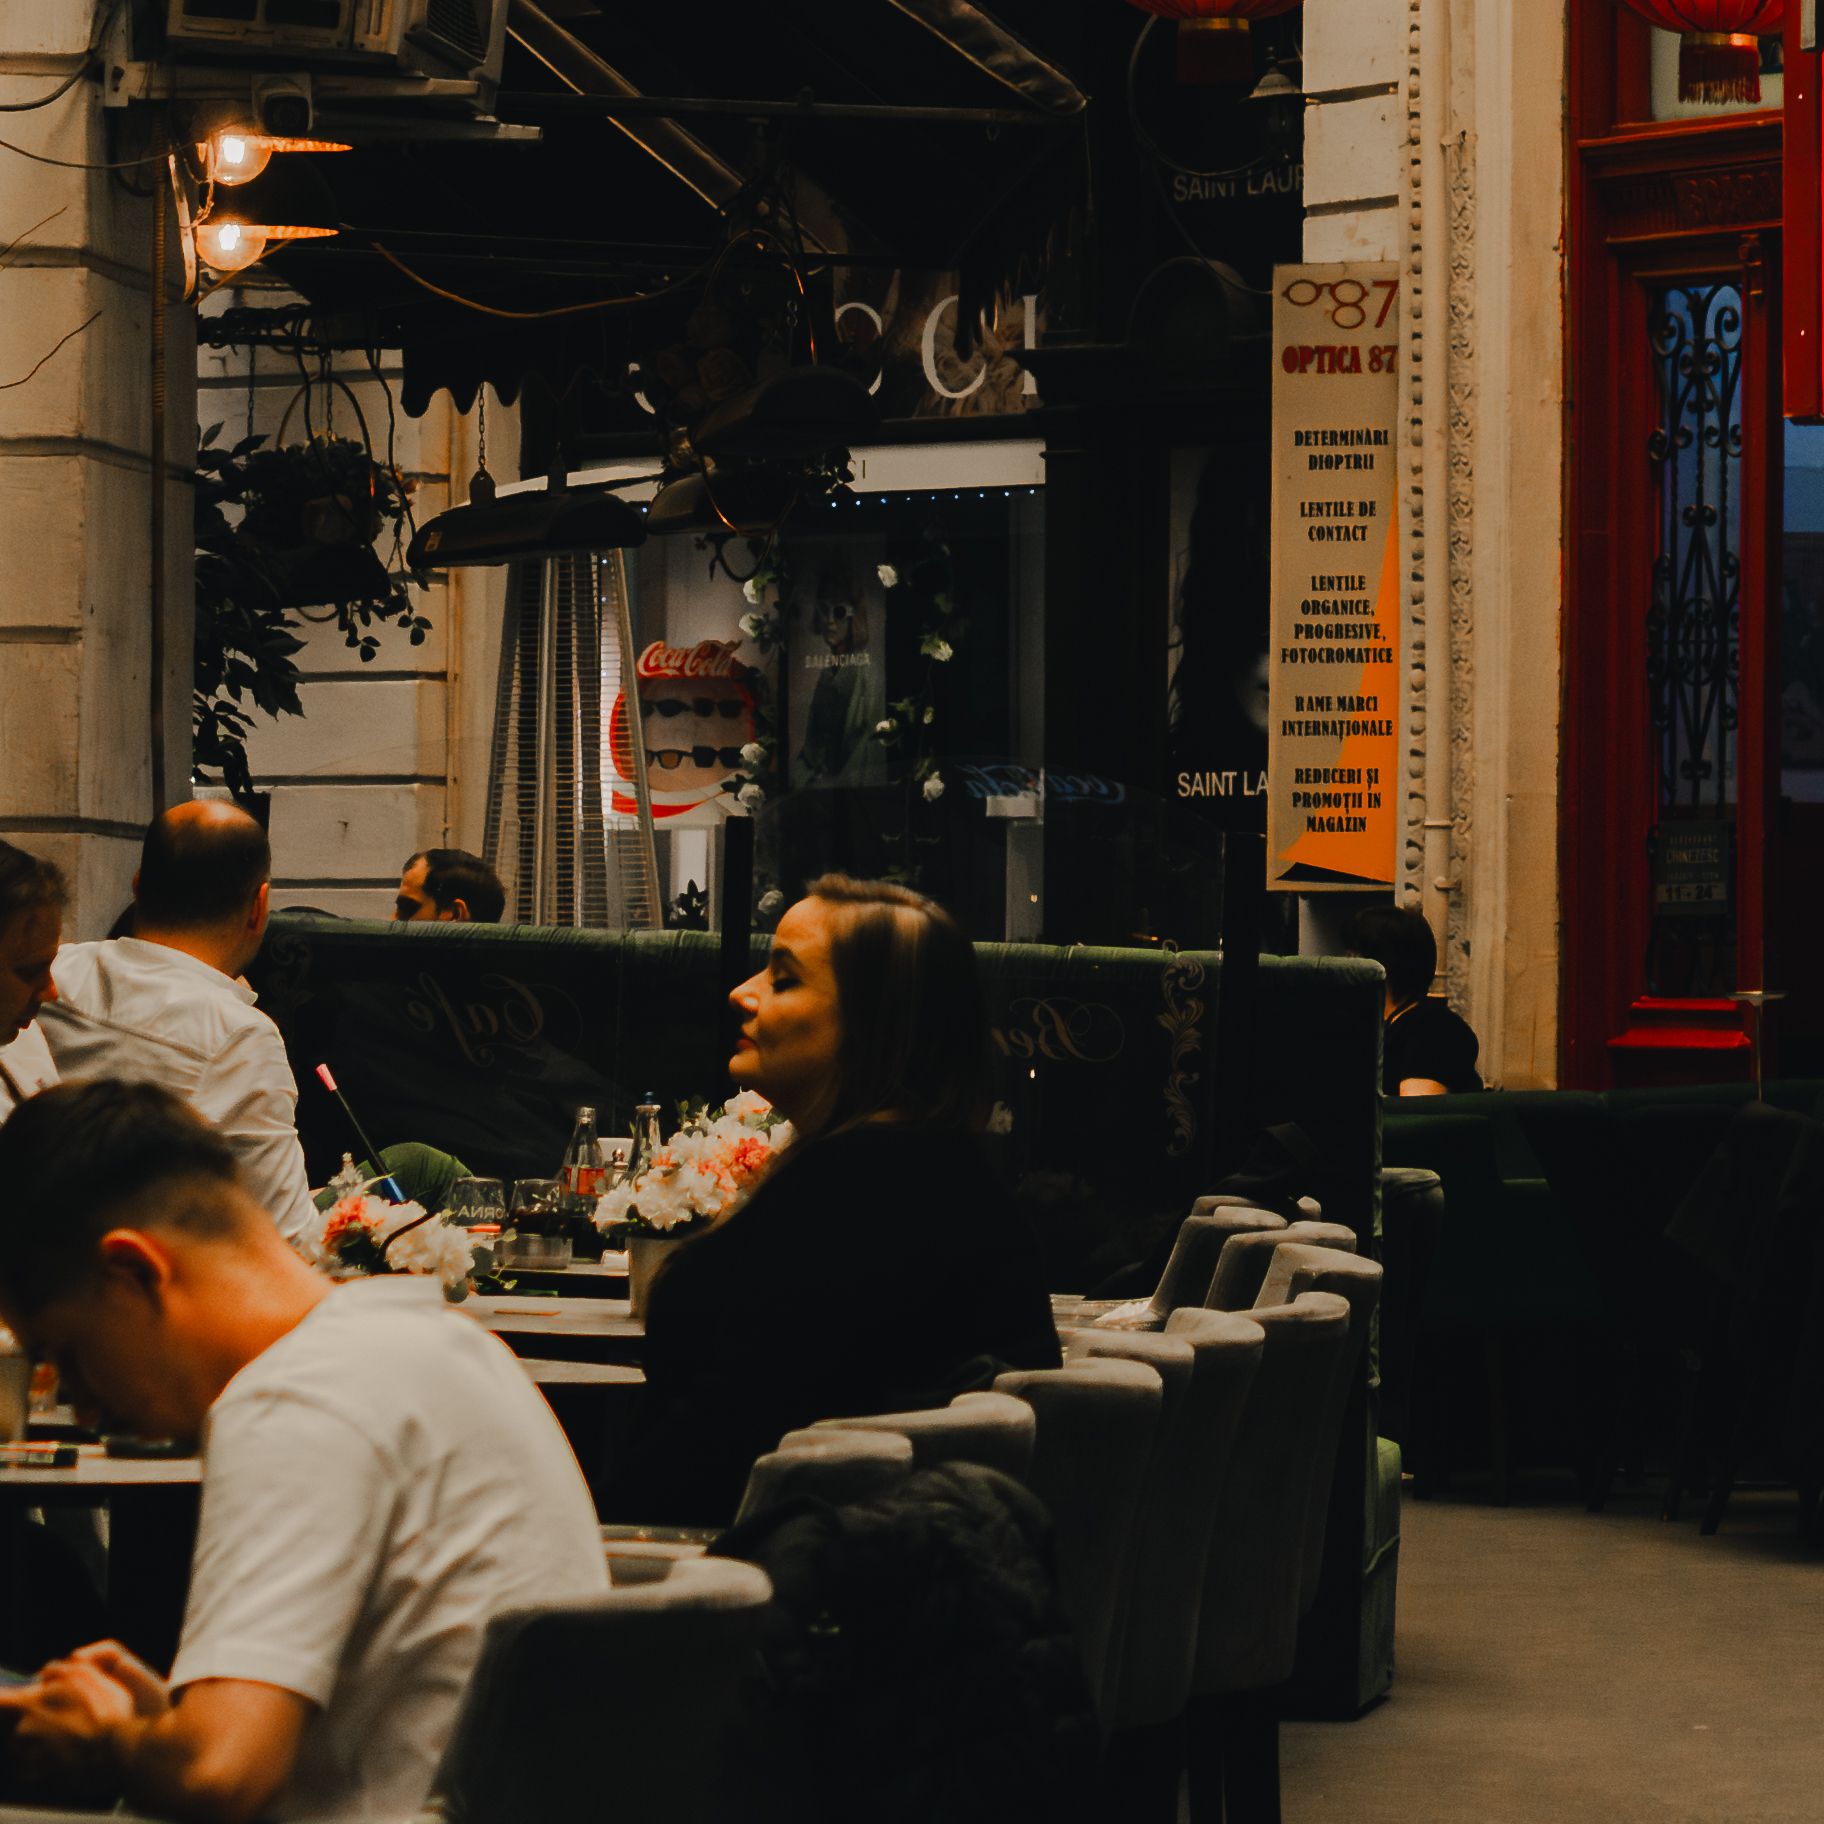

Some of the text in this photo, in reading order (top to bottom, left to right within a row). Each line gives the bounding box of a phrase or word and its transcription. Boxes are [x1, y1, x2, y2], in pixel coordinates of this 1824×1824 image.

[1173, 172, 1237, 202] SAINT
[1281, 345, 1399, 374] OPTICA 87
[1308, 454, 1374, 471] DIOPTRII
[1300, 500, 1377, 518] LENTILE DE
[1307, 525, 1368, 542] CONTACT
[1311, 575, 1366, 592] LENTILE
[1301, 599, 1375, 617] ORGANICE,
[1293, 623, 1386, 642] PROGRESIVE,
[1281, 647, 1393, 664] FOTOCROMATICE
[1295, 695, 1378, 712] RAME MARCI
[1177, 771, 1238, 798] SAINT
[1294, 768, 1362, 785] REDUCERI
[1306, 816, 1367, 833] MAGAZIN
